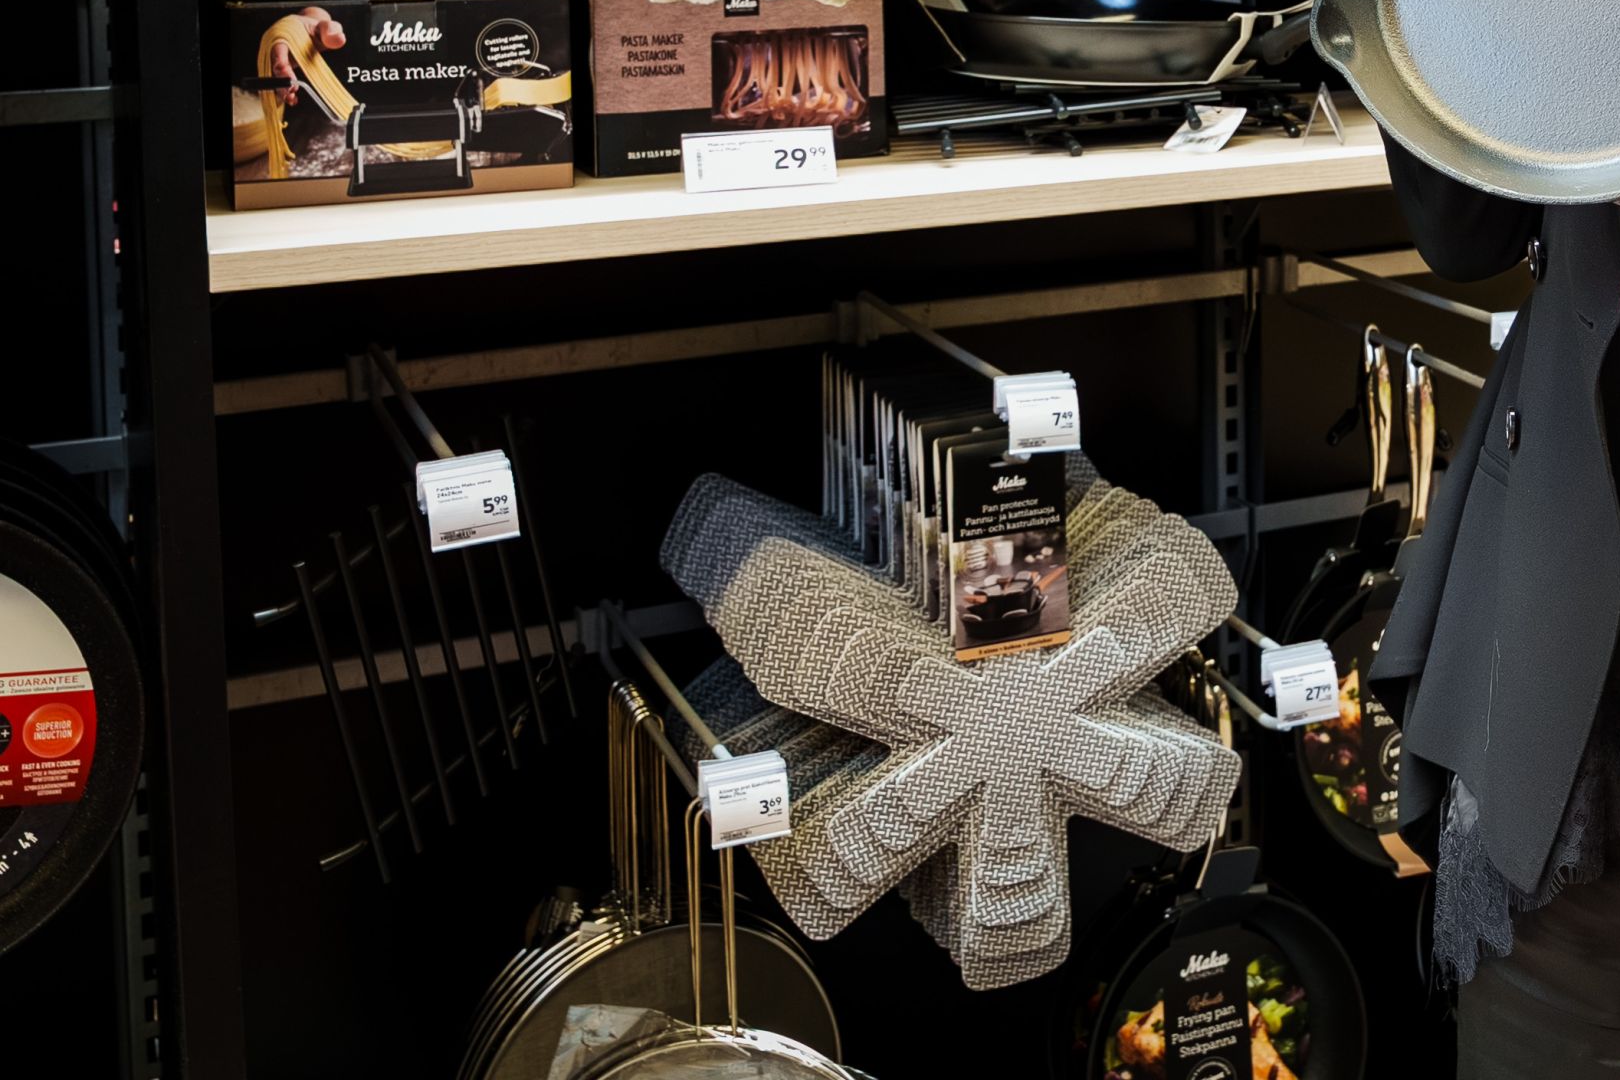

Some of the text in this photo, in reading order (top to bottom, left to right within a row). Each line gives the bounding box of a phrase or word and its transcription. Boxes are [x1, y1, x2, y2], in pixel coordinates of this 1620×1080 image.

[370, 20, 442, 47] Maku
[621, 33, 684, 47] PASTA MAKER
[378, 42, 435, 53] KITCHEN LIFE
[627, 49, 678, 63] PASTAKONE
[347, 63, 467, 83] Pasta maker
[992, 474, 1028, 492] Maku
[982, 499, 1039, 513] Pan protector
[965, 506, 1055, 526] Pannu- ja kattilasuoja
[960, 527, 986, 537] Pann-
[988, 523, 1005, 533] och
[8, 675, 79, 688] GUARANTEE
[35, 720, 72, 732] SUPERIOR
[33, 730, 73, 741] INDUCTION
[21, 762, 35, 770] FAST
[41, 761, 56, 769] EVEN
[1180, 950, 1231, 978] Maku
[1177, 1005, 1236, 1028] Frying pan
[1171, 1018, 1244, 1045] Paistinpannu
[1179, 1035, 1237, 1058] Stekpanna
